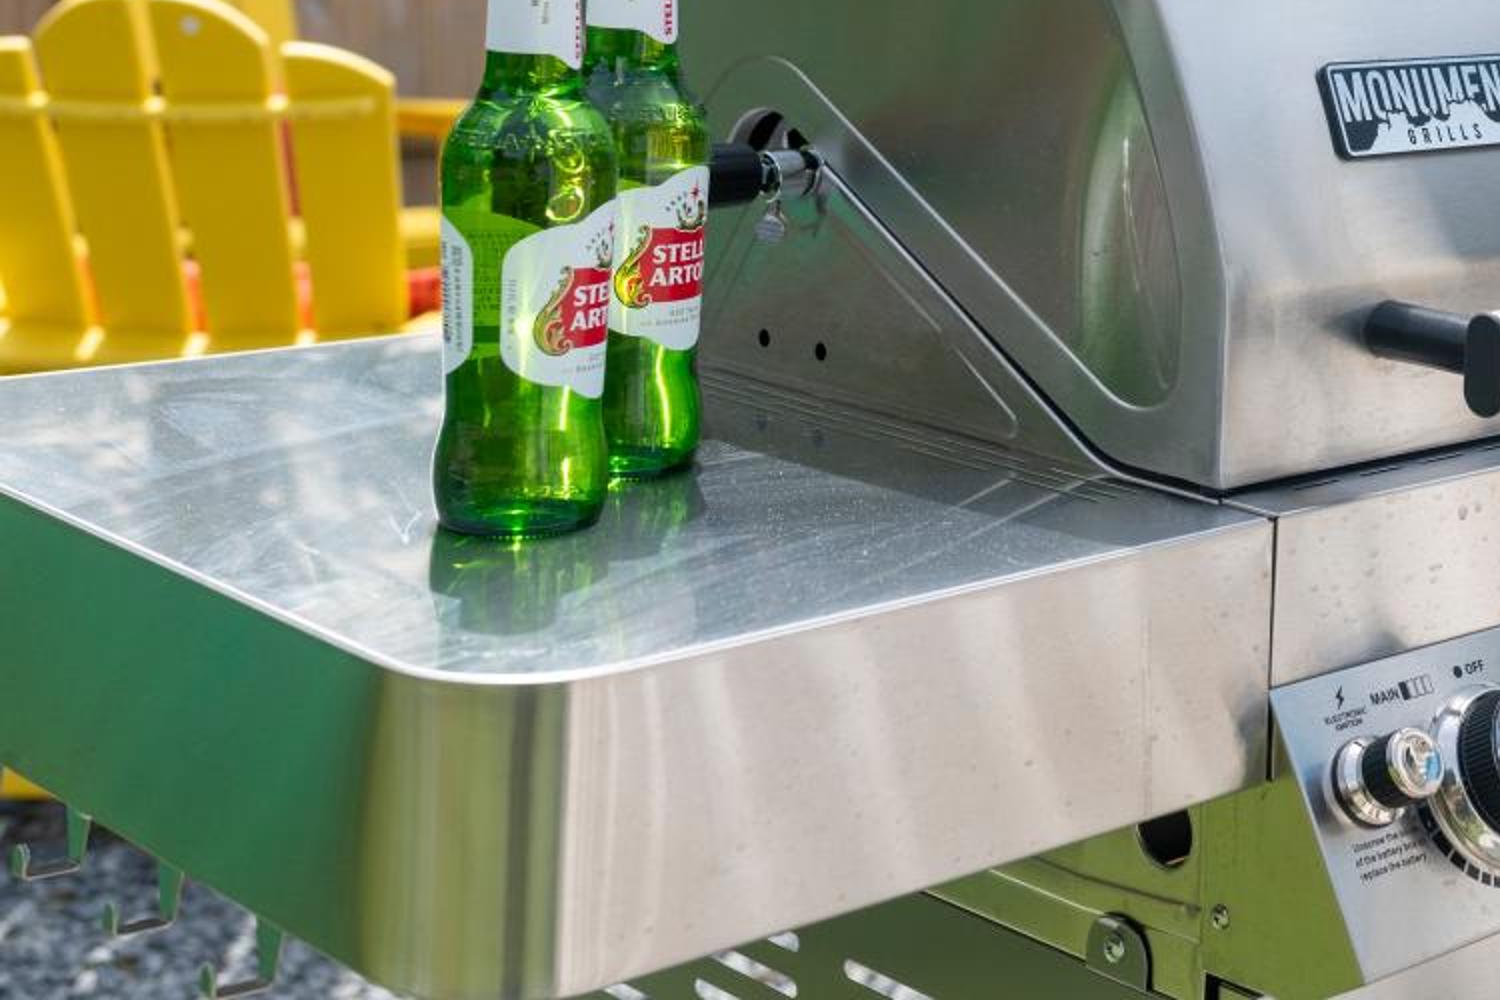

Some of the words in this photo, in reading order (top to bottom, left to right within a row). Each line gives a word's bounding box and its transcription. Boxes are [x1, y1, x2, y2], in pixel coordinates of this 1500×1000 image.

[1407, 123, 1483, 145] GRILLS
[652, 238, 704, 264] STELL
[648, 260, 704, 287] ARTO
[573, 282, 609, 307] STE
[569, 305, 608, 331] ART
[1464, 659, 1484, 675] OFF
[1369, 687, 1401, 705] MAIN
